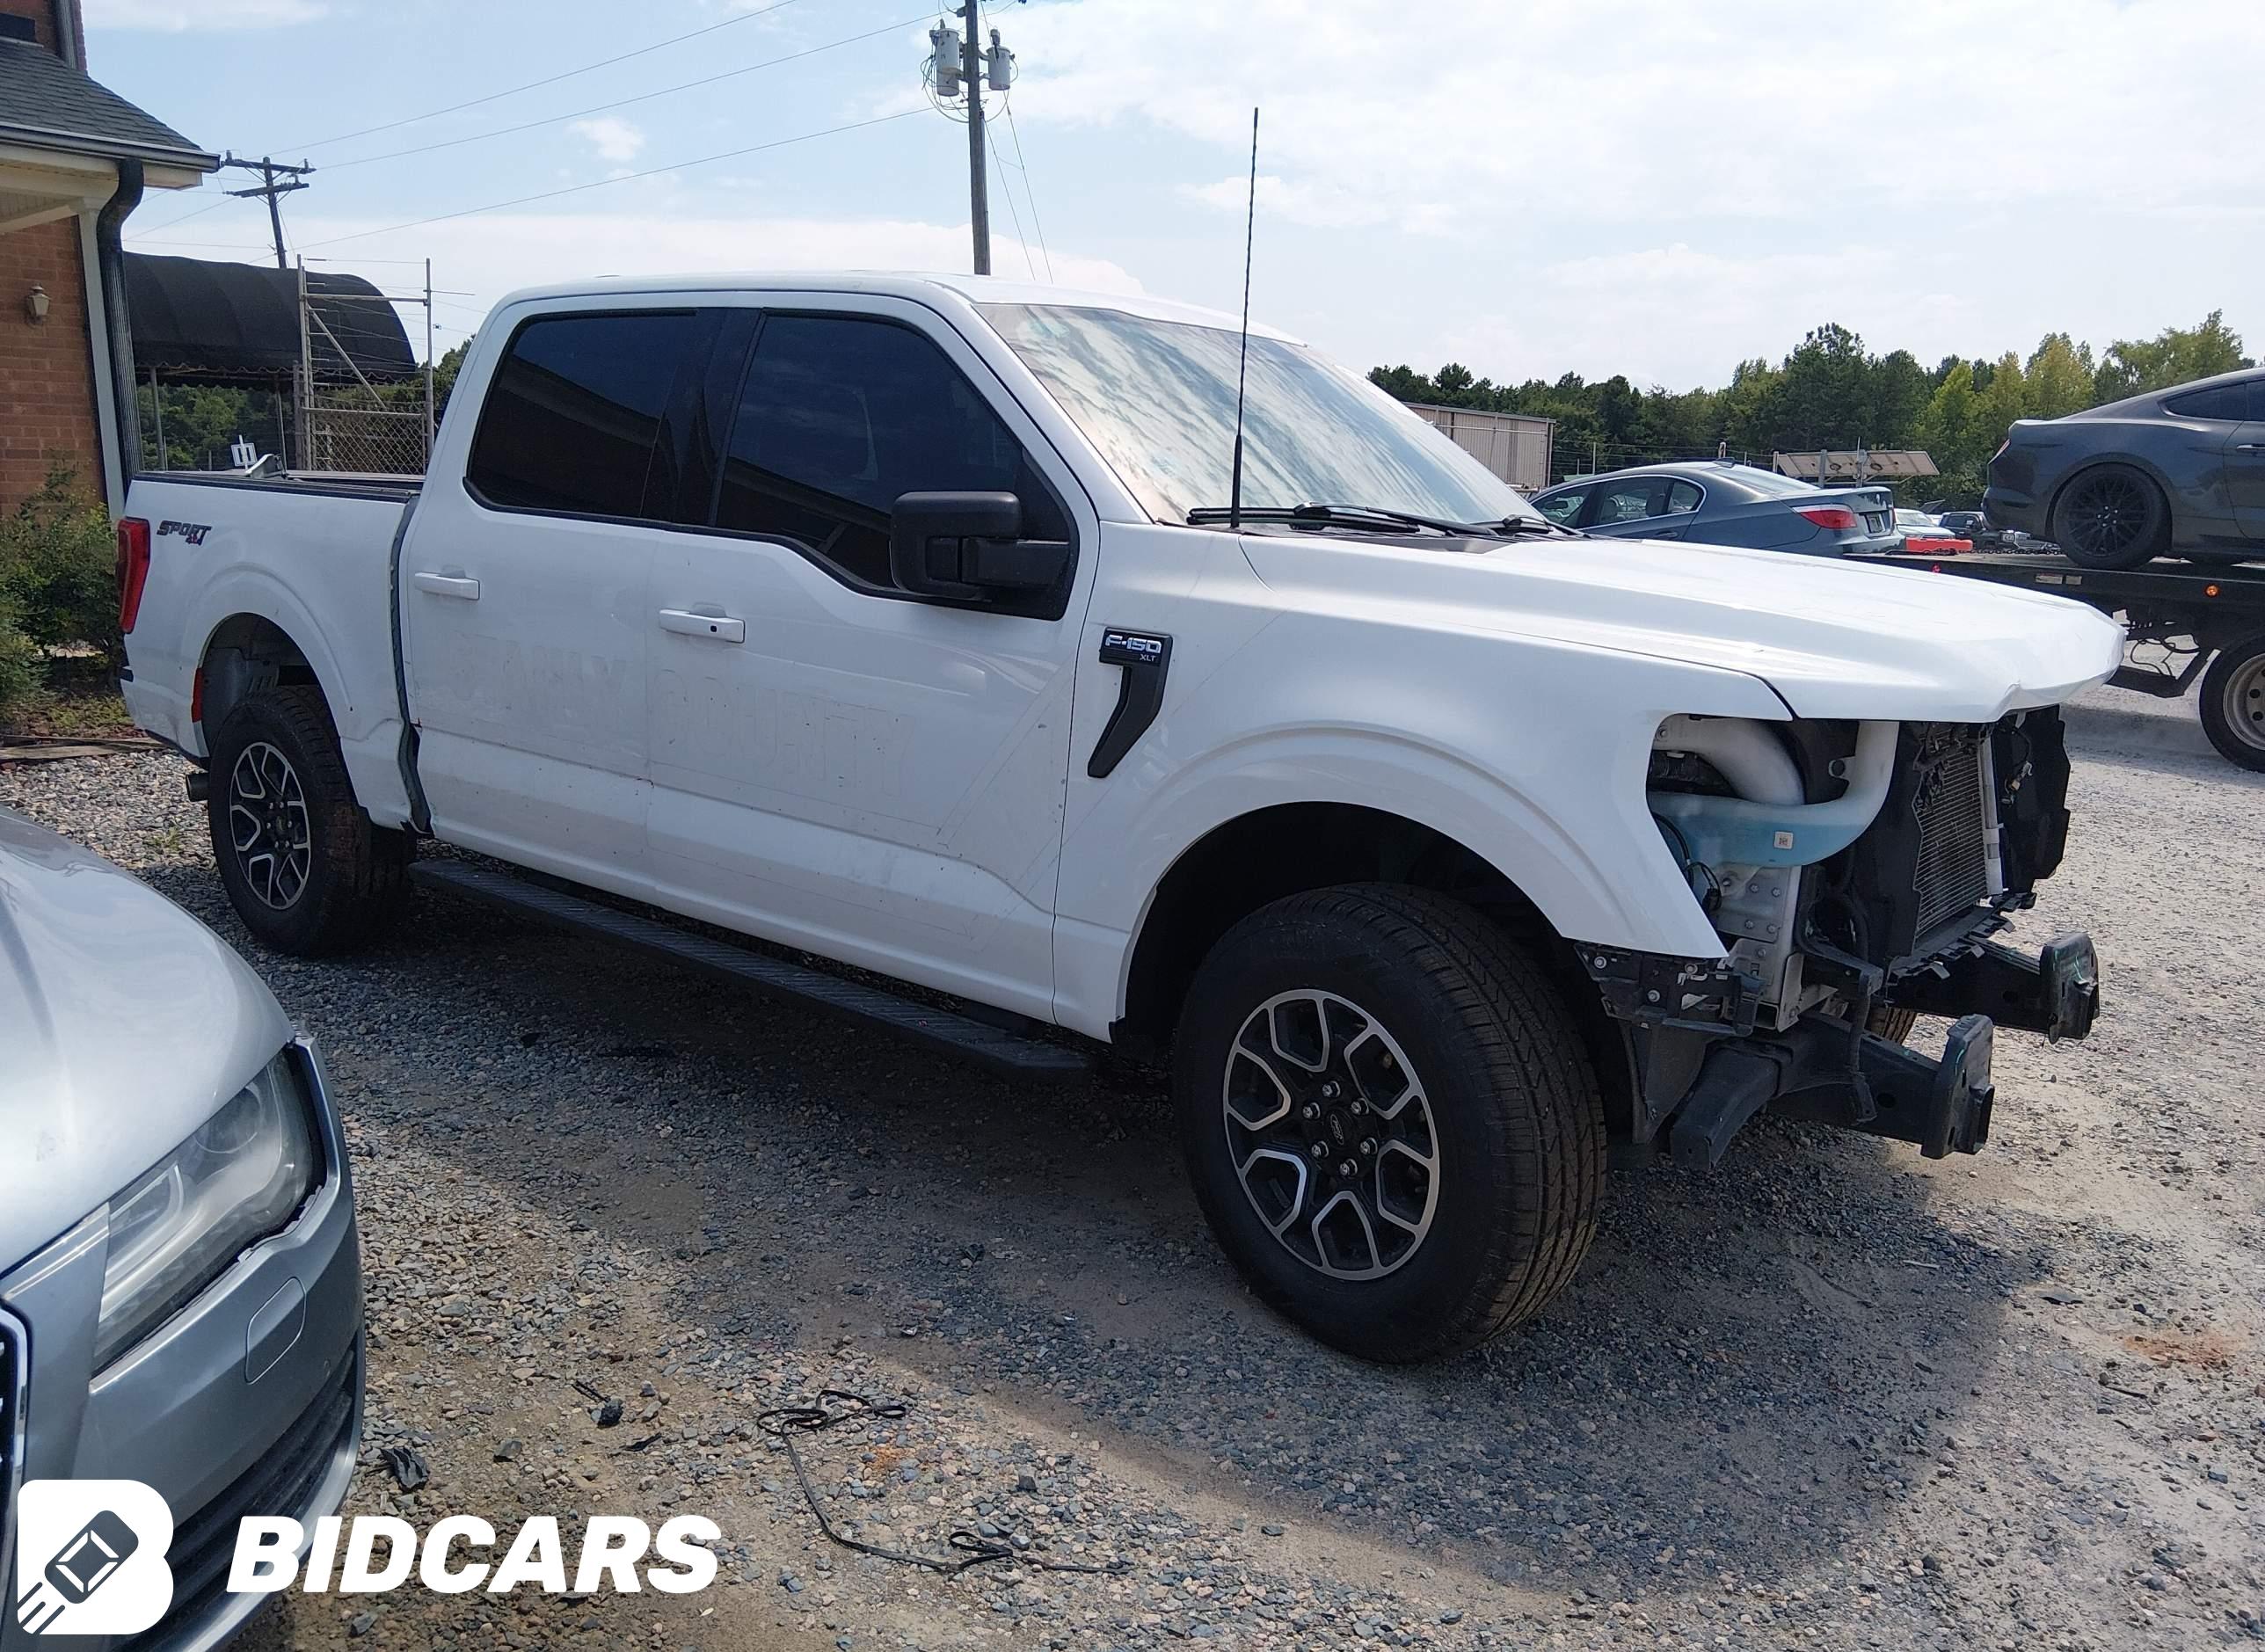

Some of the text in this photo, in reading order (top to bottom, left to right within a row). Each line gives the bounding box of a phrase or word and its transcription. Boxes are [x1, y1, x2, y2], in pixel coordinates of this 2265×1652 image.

[157, 520, 213, 540] SPORT
[1105, 634, 1162, 653] F-150
[1139, 653, 1156, 662] XLT
